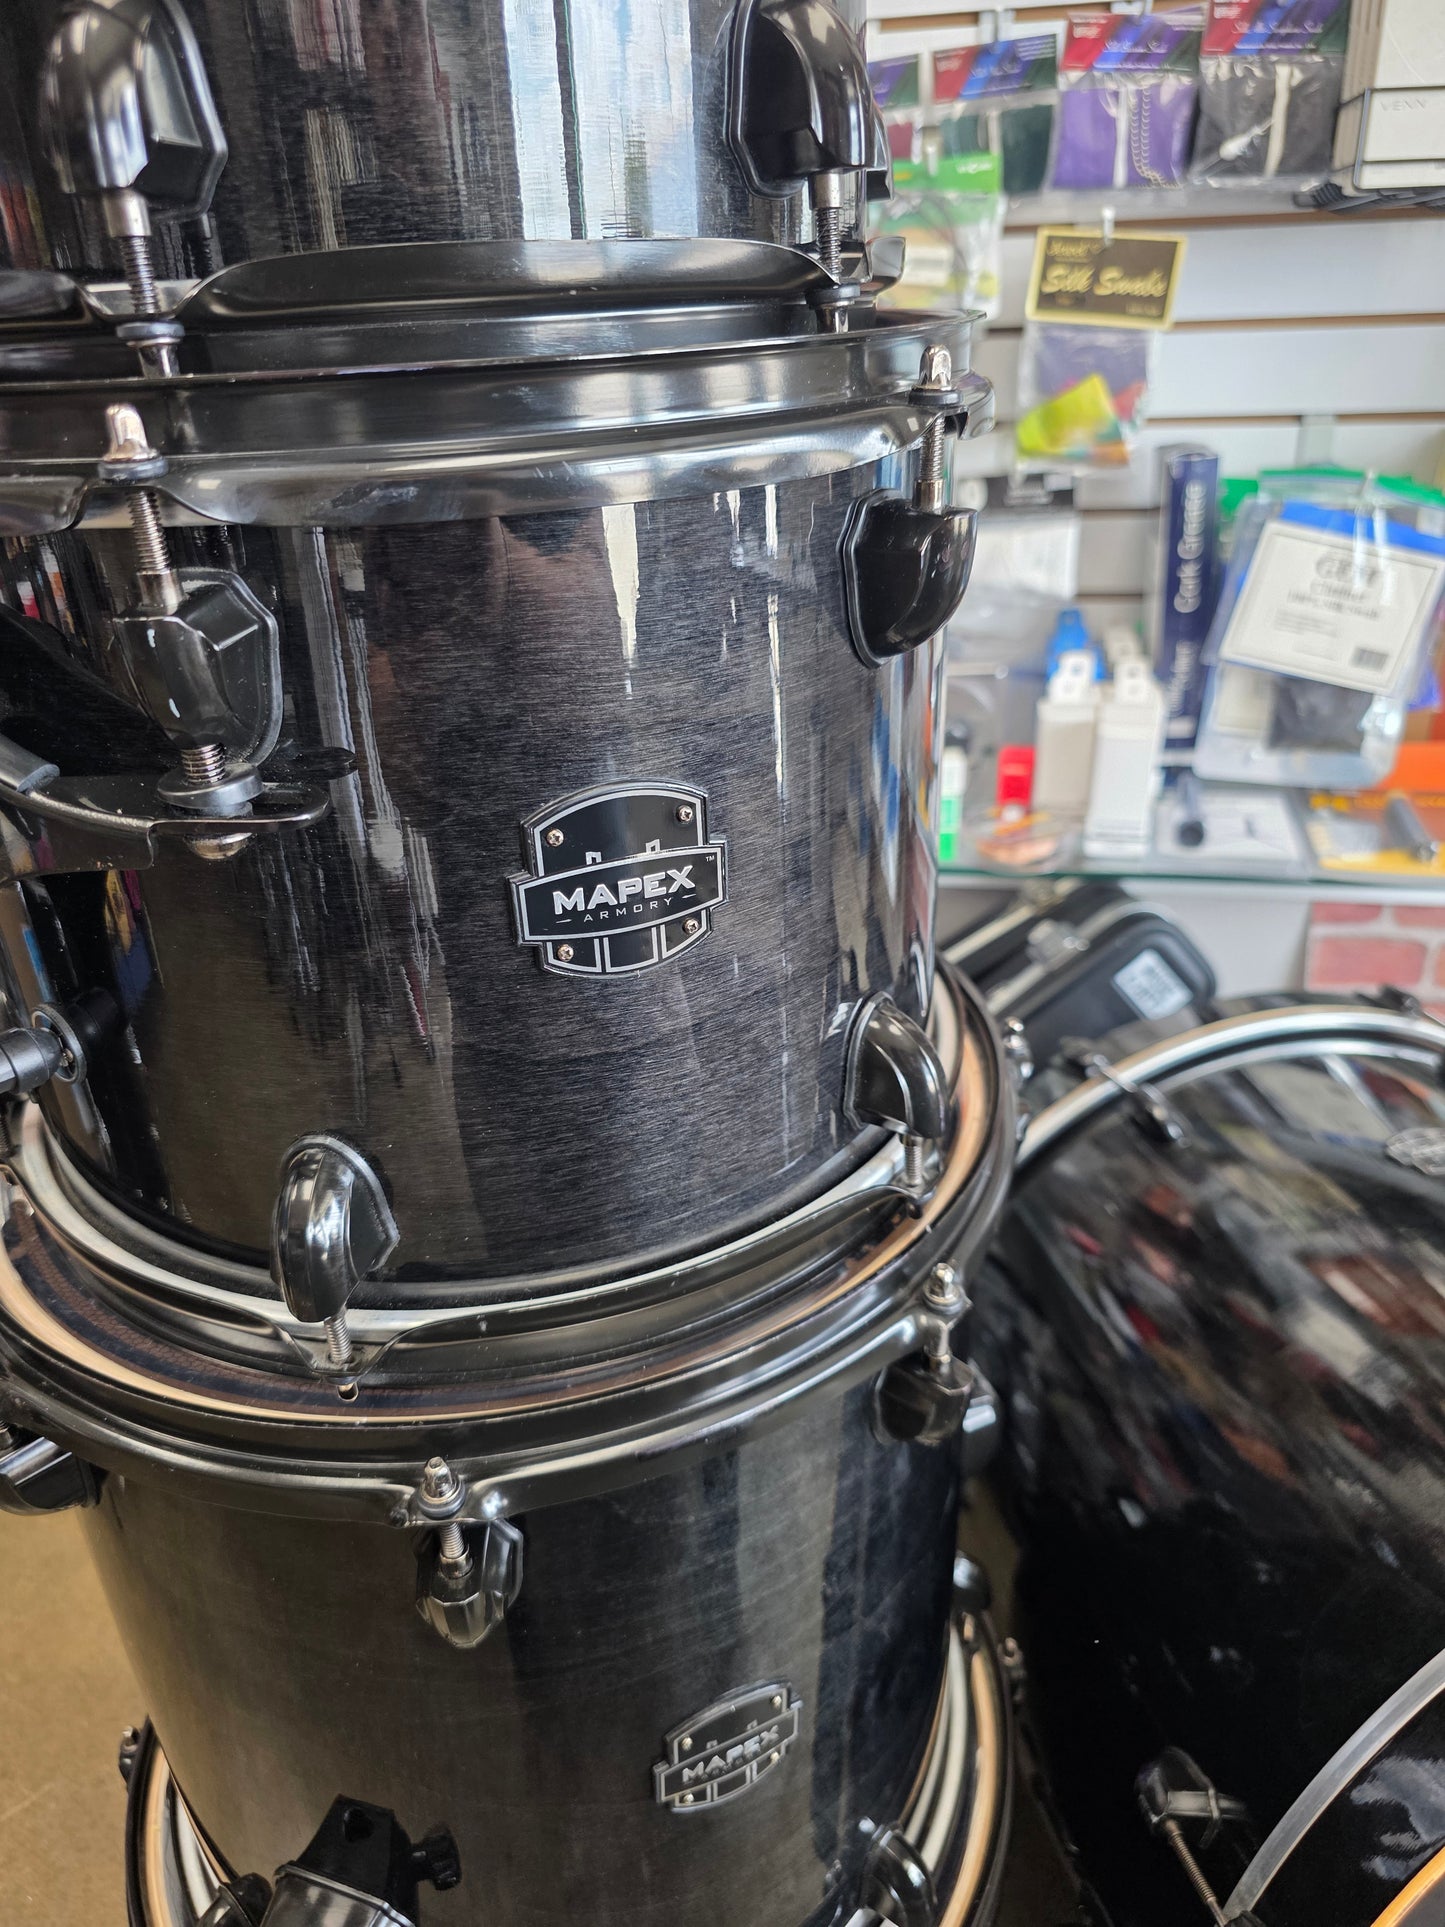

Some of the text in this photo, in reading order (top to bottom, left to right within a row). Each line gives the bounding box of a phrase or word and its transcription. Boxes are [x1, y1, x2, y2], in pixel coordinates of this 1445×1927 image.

[552, 864, 696, 916] MAPEX
[583, 897, 673, 923] ARMORY
[682, 1724, 779, 1784] MAPEX
